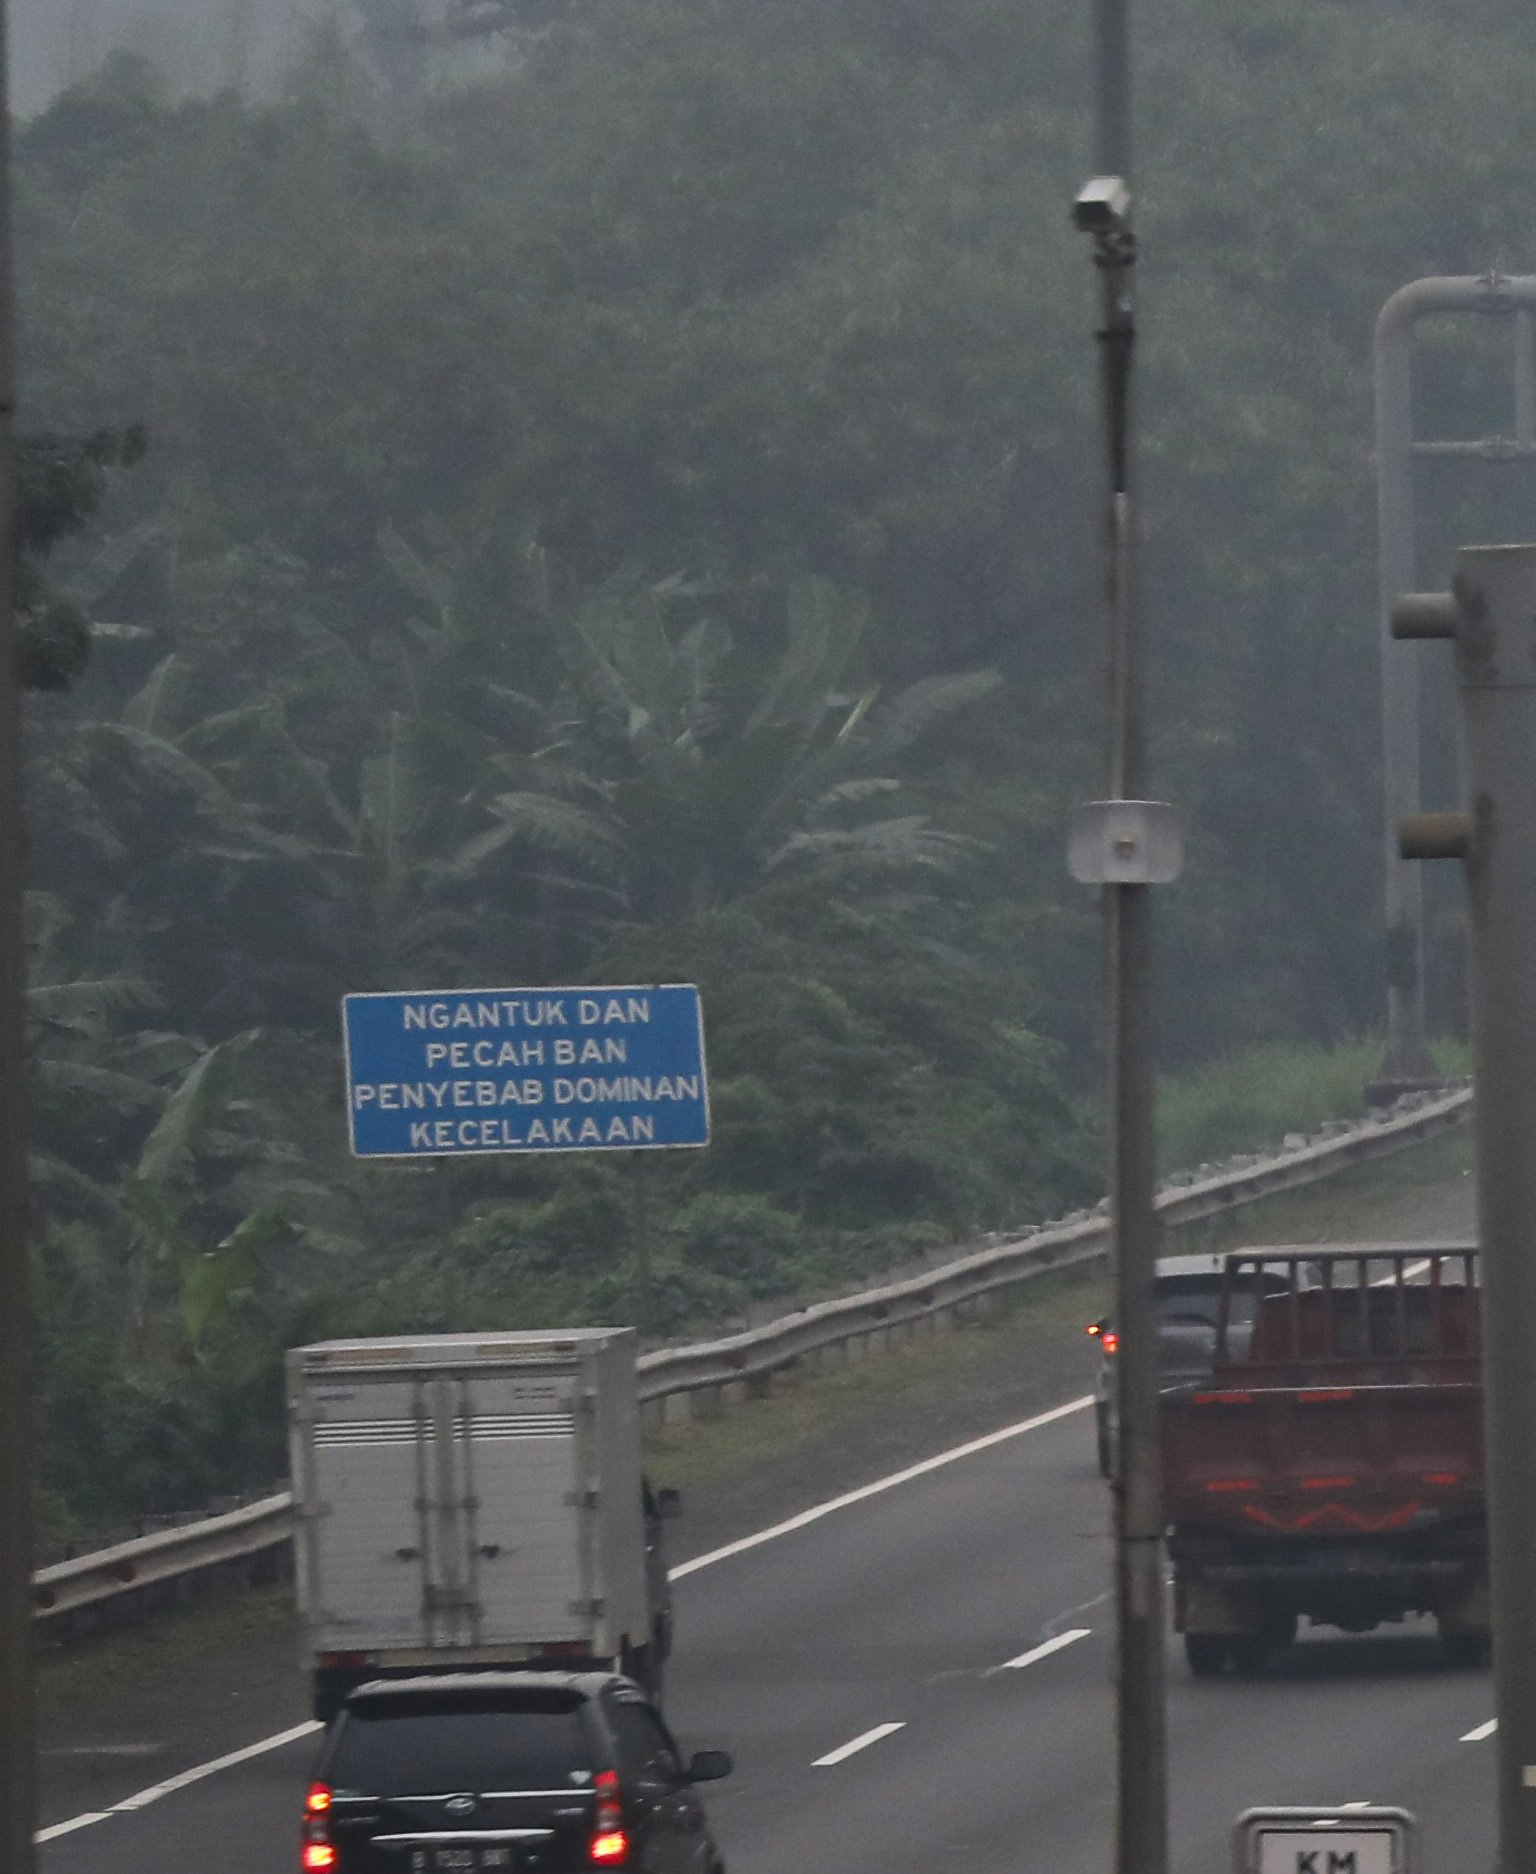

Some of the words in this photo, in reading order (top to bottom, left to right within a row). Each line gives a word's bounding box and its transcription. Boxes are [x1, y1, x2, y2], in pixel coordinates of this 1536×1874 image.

[404, 1001, 565, 1030] NGANTUK
[581, 999, 650, 1024] DAN
[427, 1040, 545, 1068] PECAH
[555, 1039, 627, 1065] BAN
[355, 1079, 544, 1110] PENYEBAB
[554, 1076, 698, 1105] DOMINAN
[411, 1116, 654, 1147] KECELAKAAN
